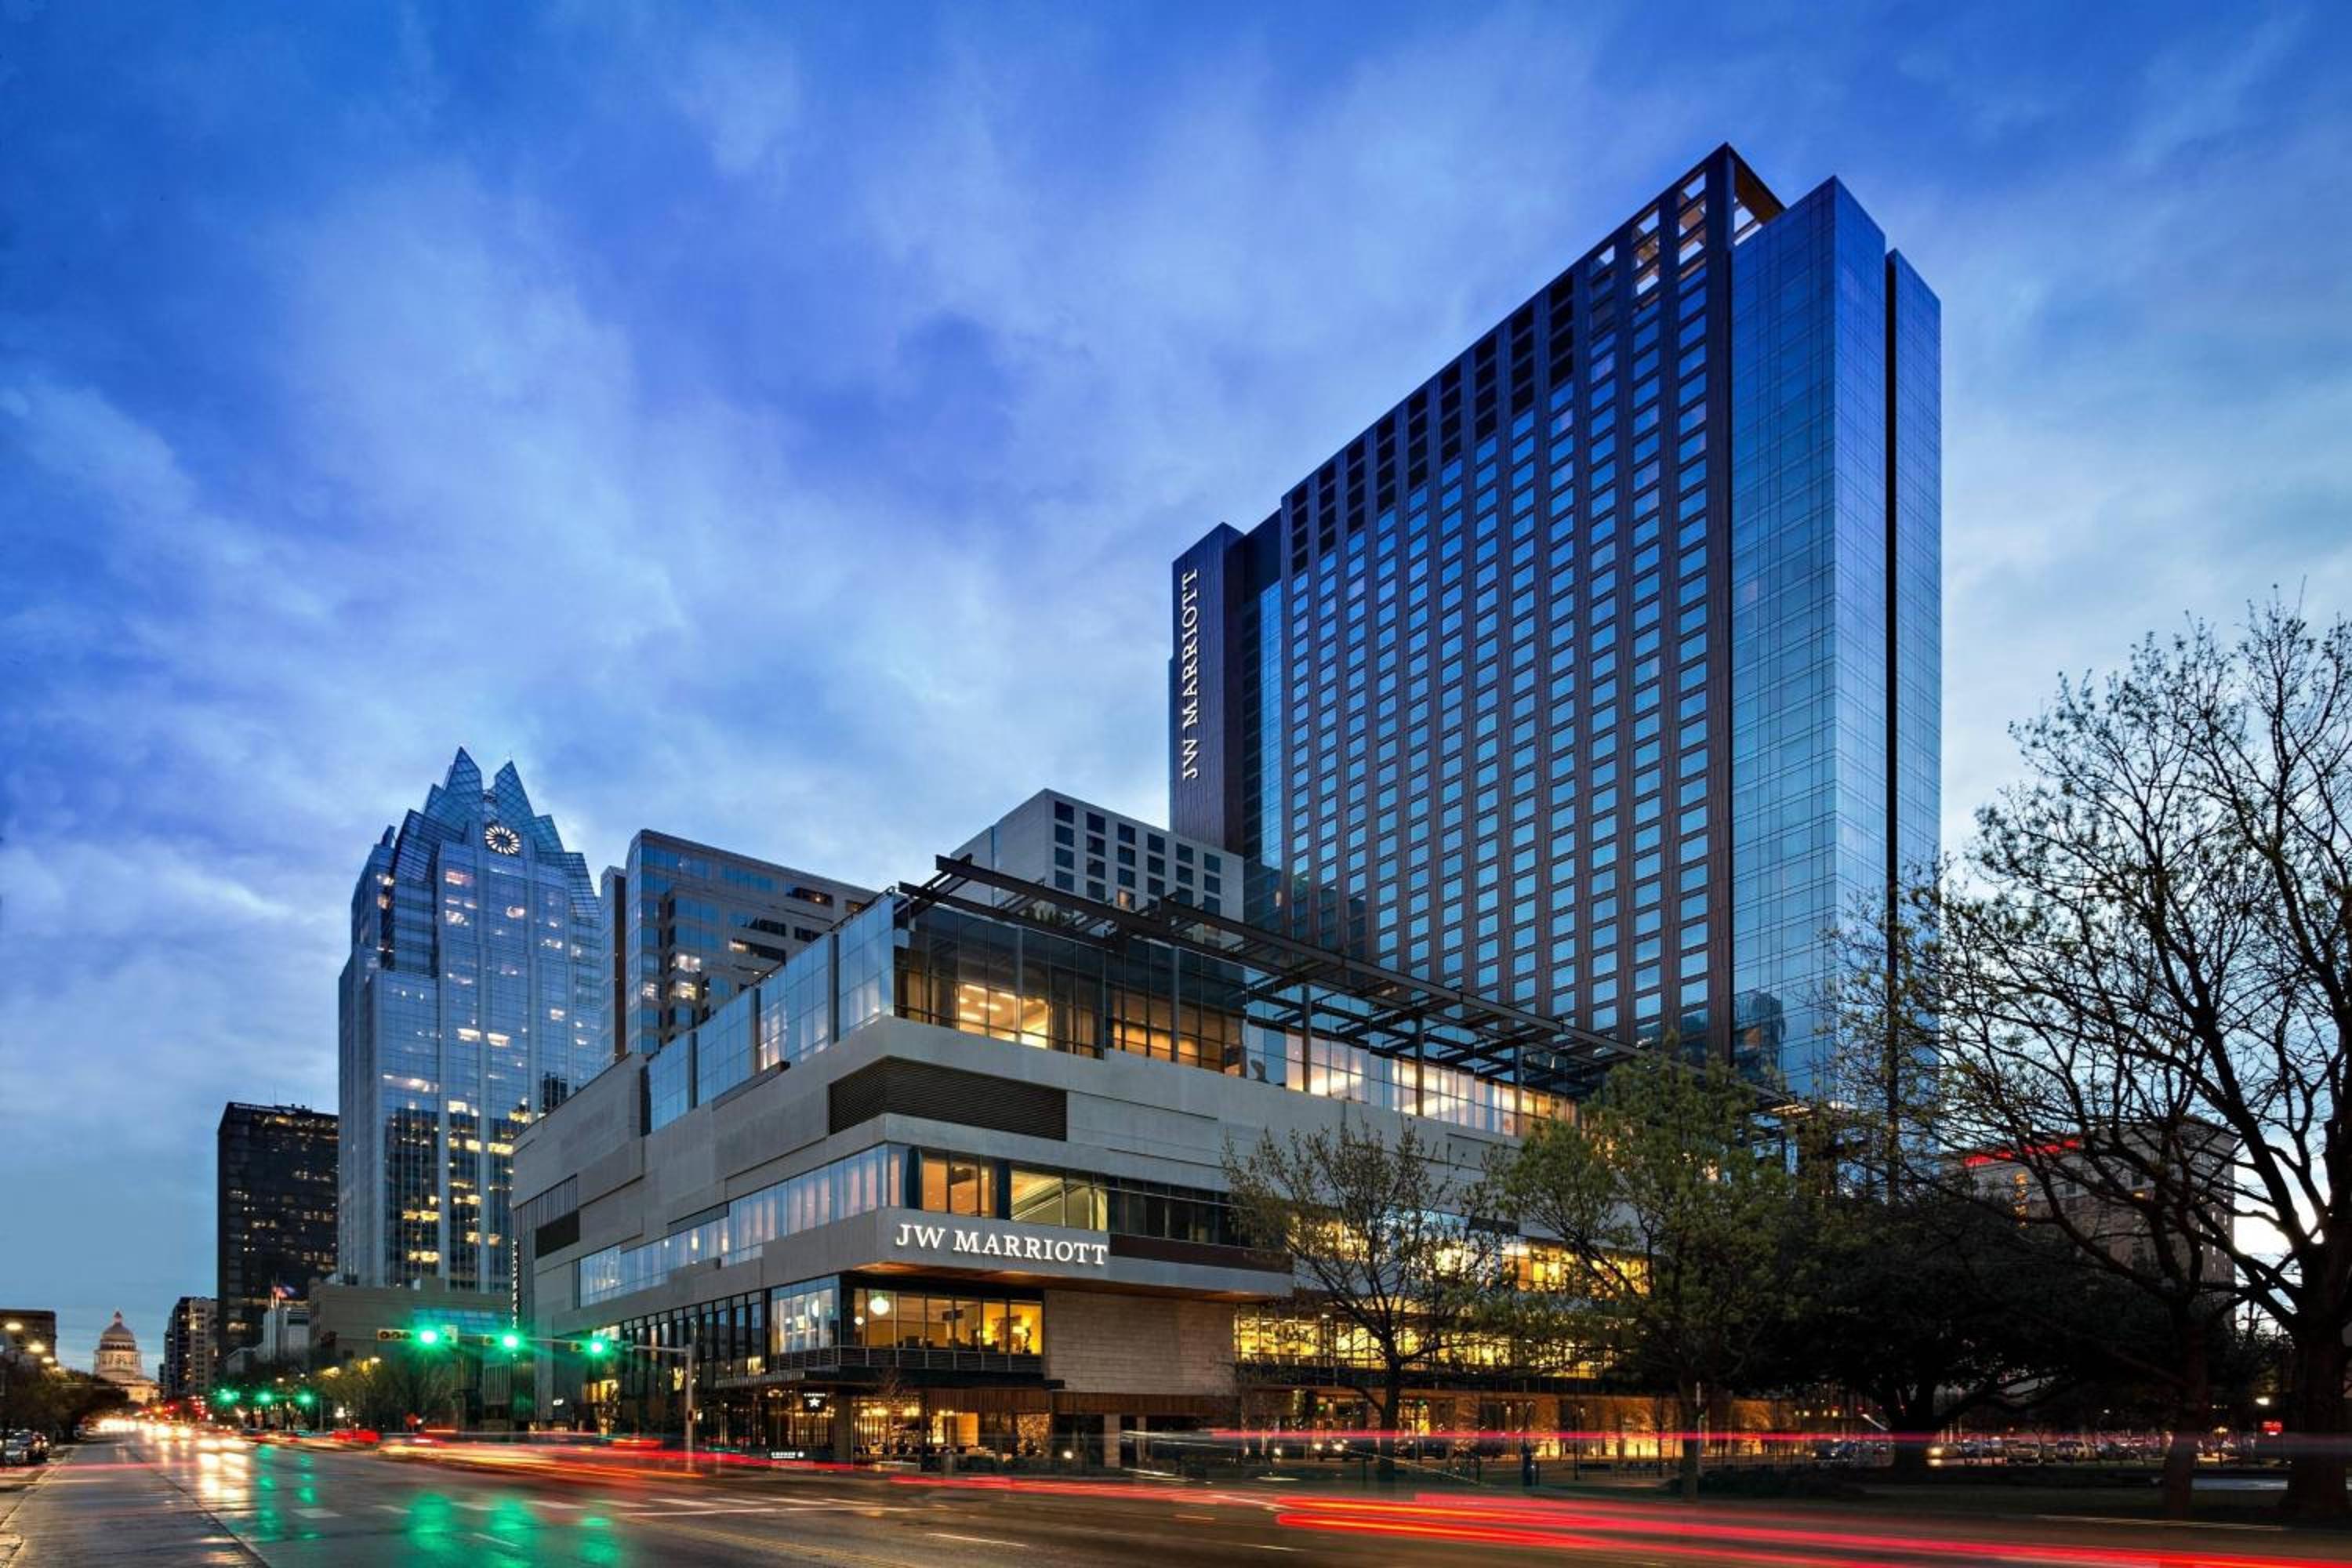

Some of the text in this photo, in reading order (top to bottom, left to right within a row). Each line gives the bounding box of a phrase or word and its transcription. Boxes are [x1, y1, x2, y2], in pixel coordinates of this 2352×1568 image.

[1182, 568, 1198, 779] JW MARRIOTT
[895, 1224, 1108, 1265] JW MARRIOTT
